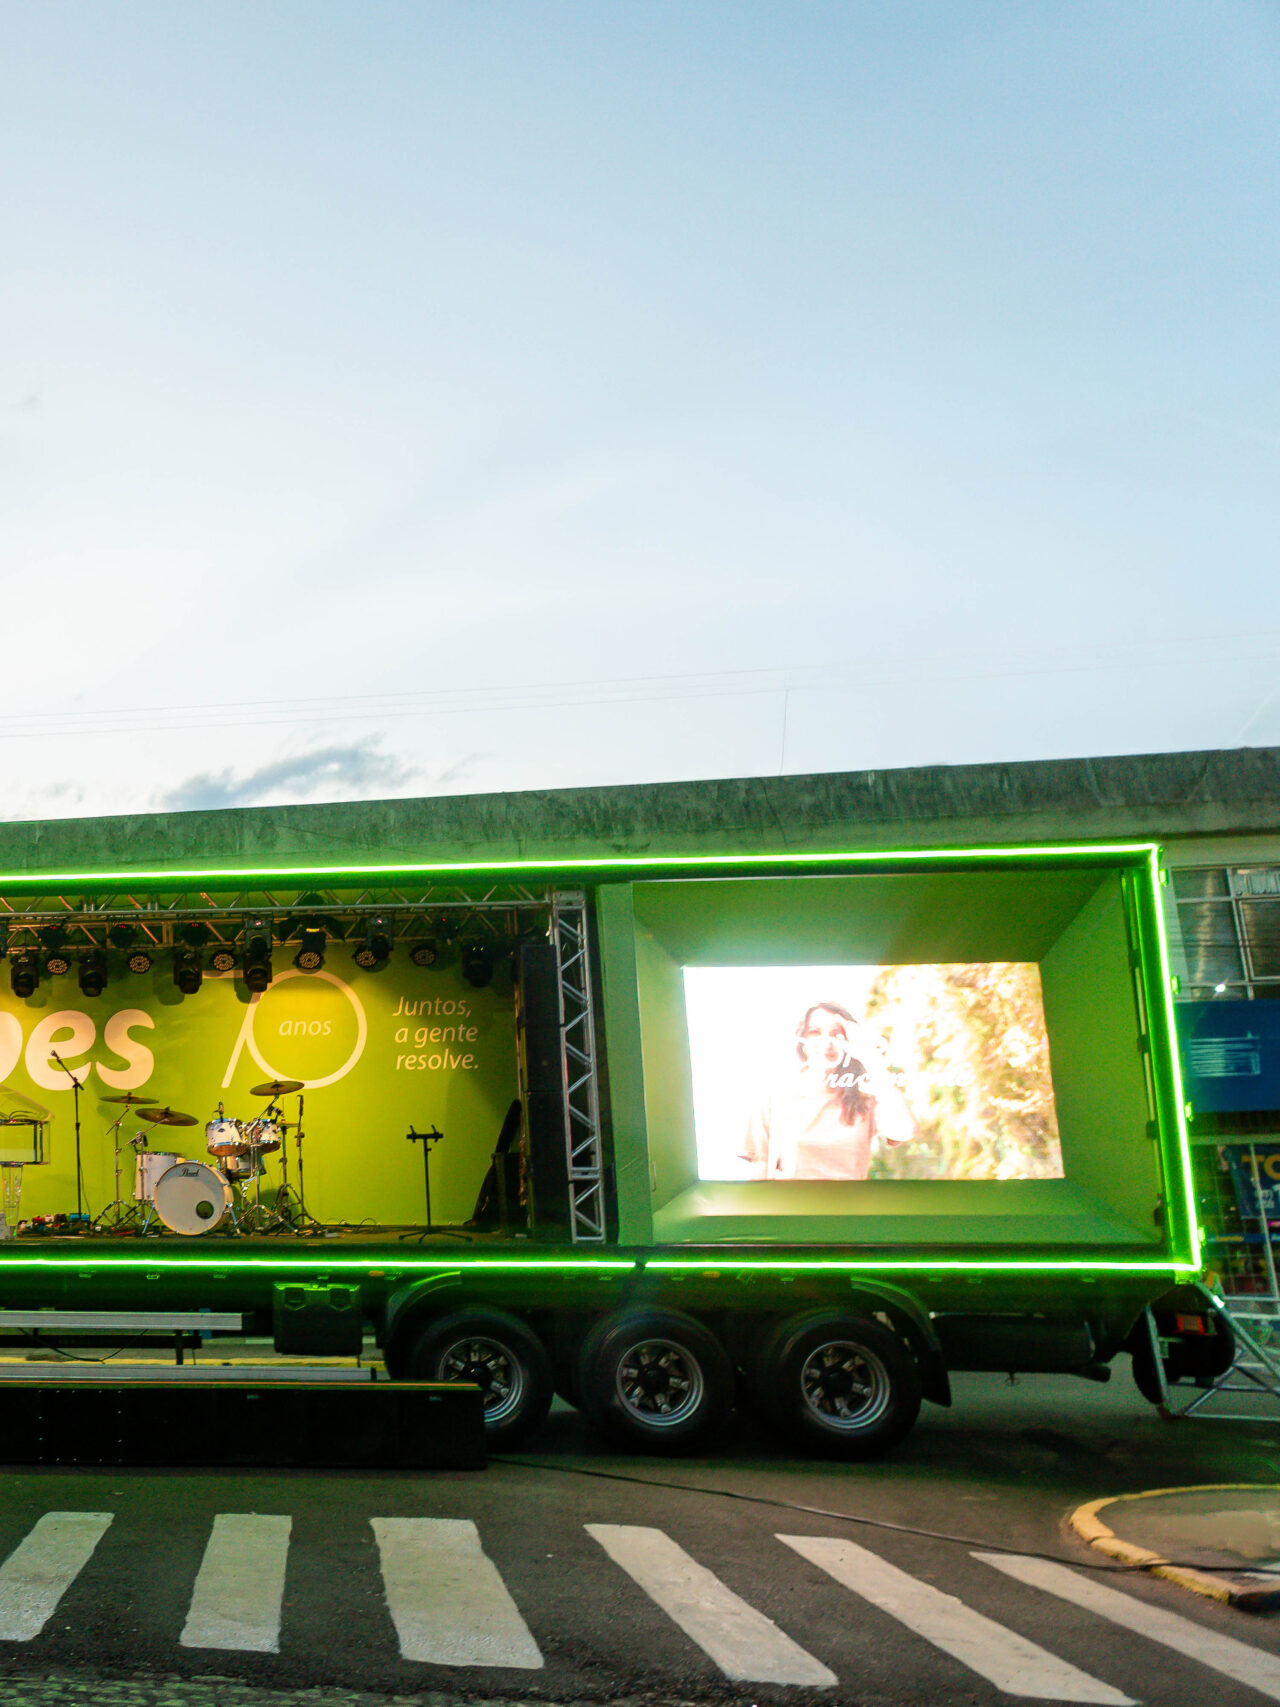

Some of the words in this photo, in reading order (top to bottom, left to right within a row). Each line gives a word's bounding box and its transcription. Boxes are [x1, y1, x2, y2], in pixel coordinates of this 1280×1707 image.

[392, 996, 472, 1018] Juntos,
[279, 1019, 333, 1037] anos
[395, 1028, 408, 1043] a
[414, 1024, 479, 1049] gente
[396, 1049, 479, 1071] resolve.
